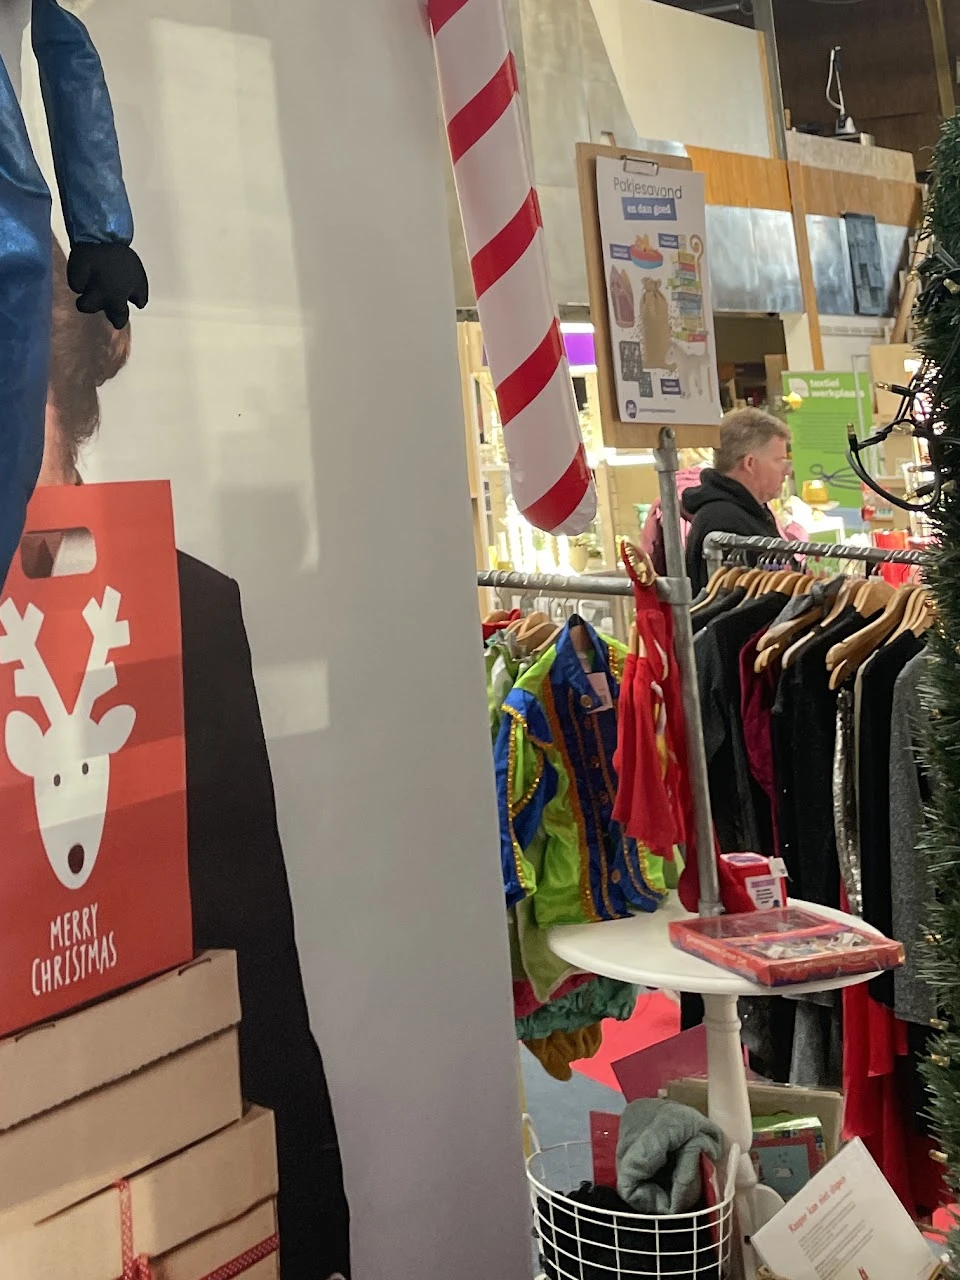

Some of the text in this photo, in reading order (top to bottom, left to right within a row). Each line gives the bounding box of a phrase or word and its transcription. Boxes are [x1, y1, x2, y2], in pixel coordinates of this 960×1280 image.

[613, 177, 683, 200] Pakjesavond
[810, 388, 865, 399] werkplaas
[50, 902, 98, 951] MERRY
[32, 931, 117, 996] CHRISTMAS
